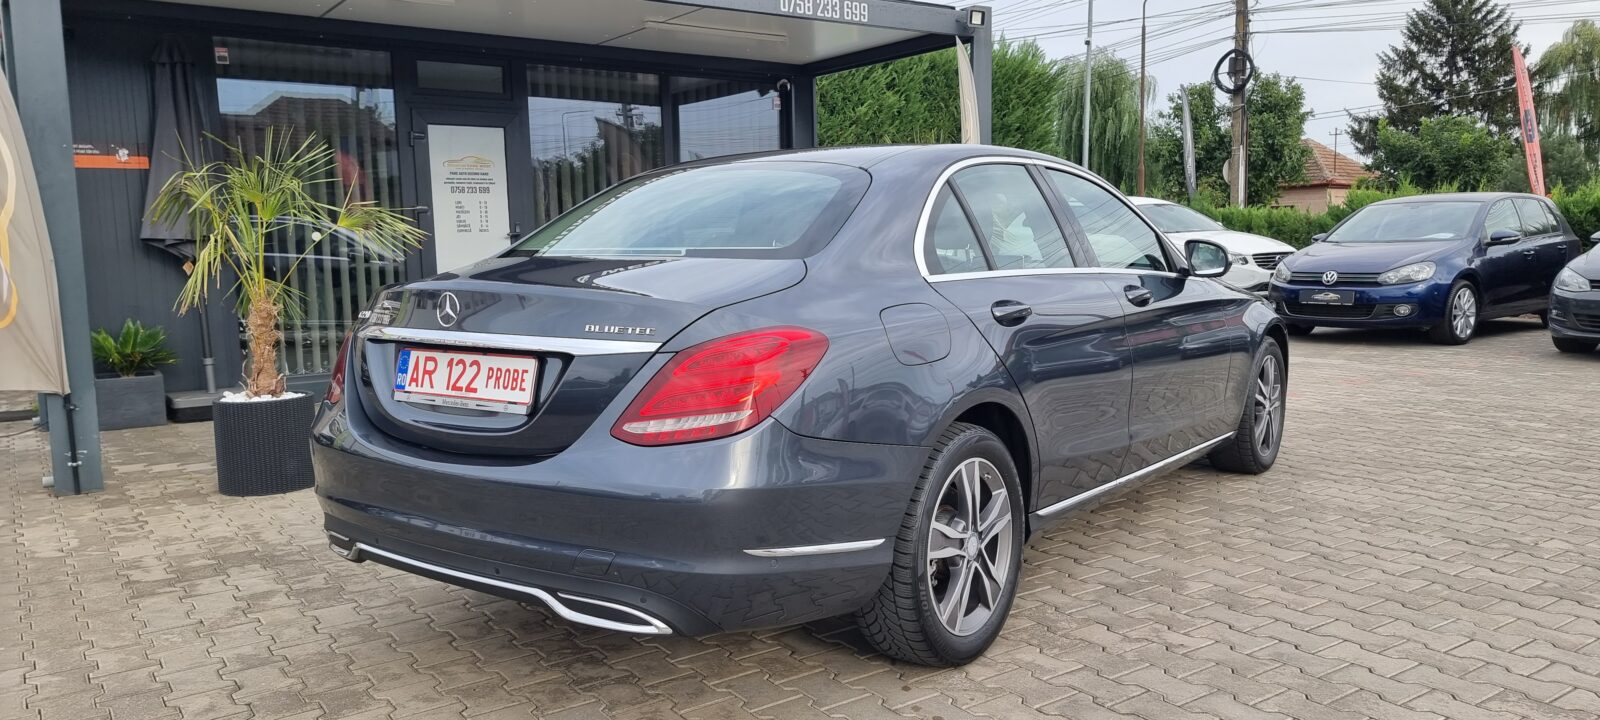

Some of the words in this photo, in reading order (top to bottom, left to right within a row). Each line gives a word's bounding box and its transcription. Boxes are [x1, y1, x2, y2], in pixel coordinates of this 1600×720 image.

[780, 0, 813, 14] 0758
[817, 0, 840, 18] 233
[844, 1, 868, 22] 699
[584, 324, 656, 336] BLUETEC
[396, 372, 407, 386] RO
[408, 355, 439, 389] AR
[445, 357, 482, 394] 122
[485, 366, 529, 392] PROBE
